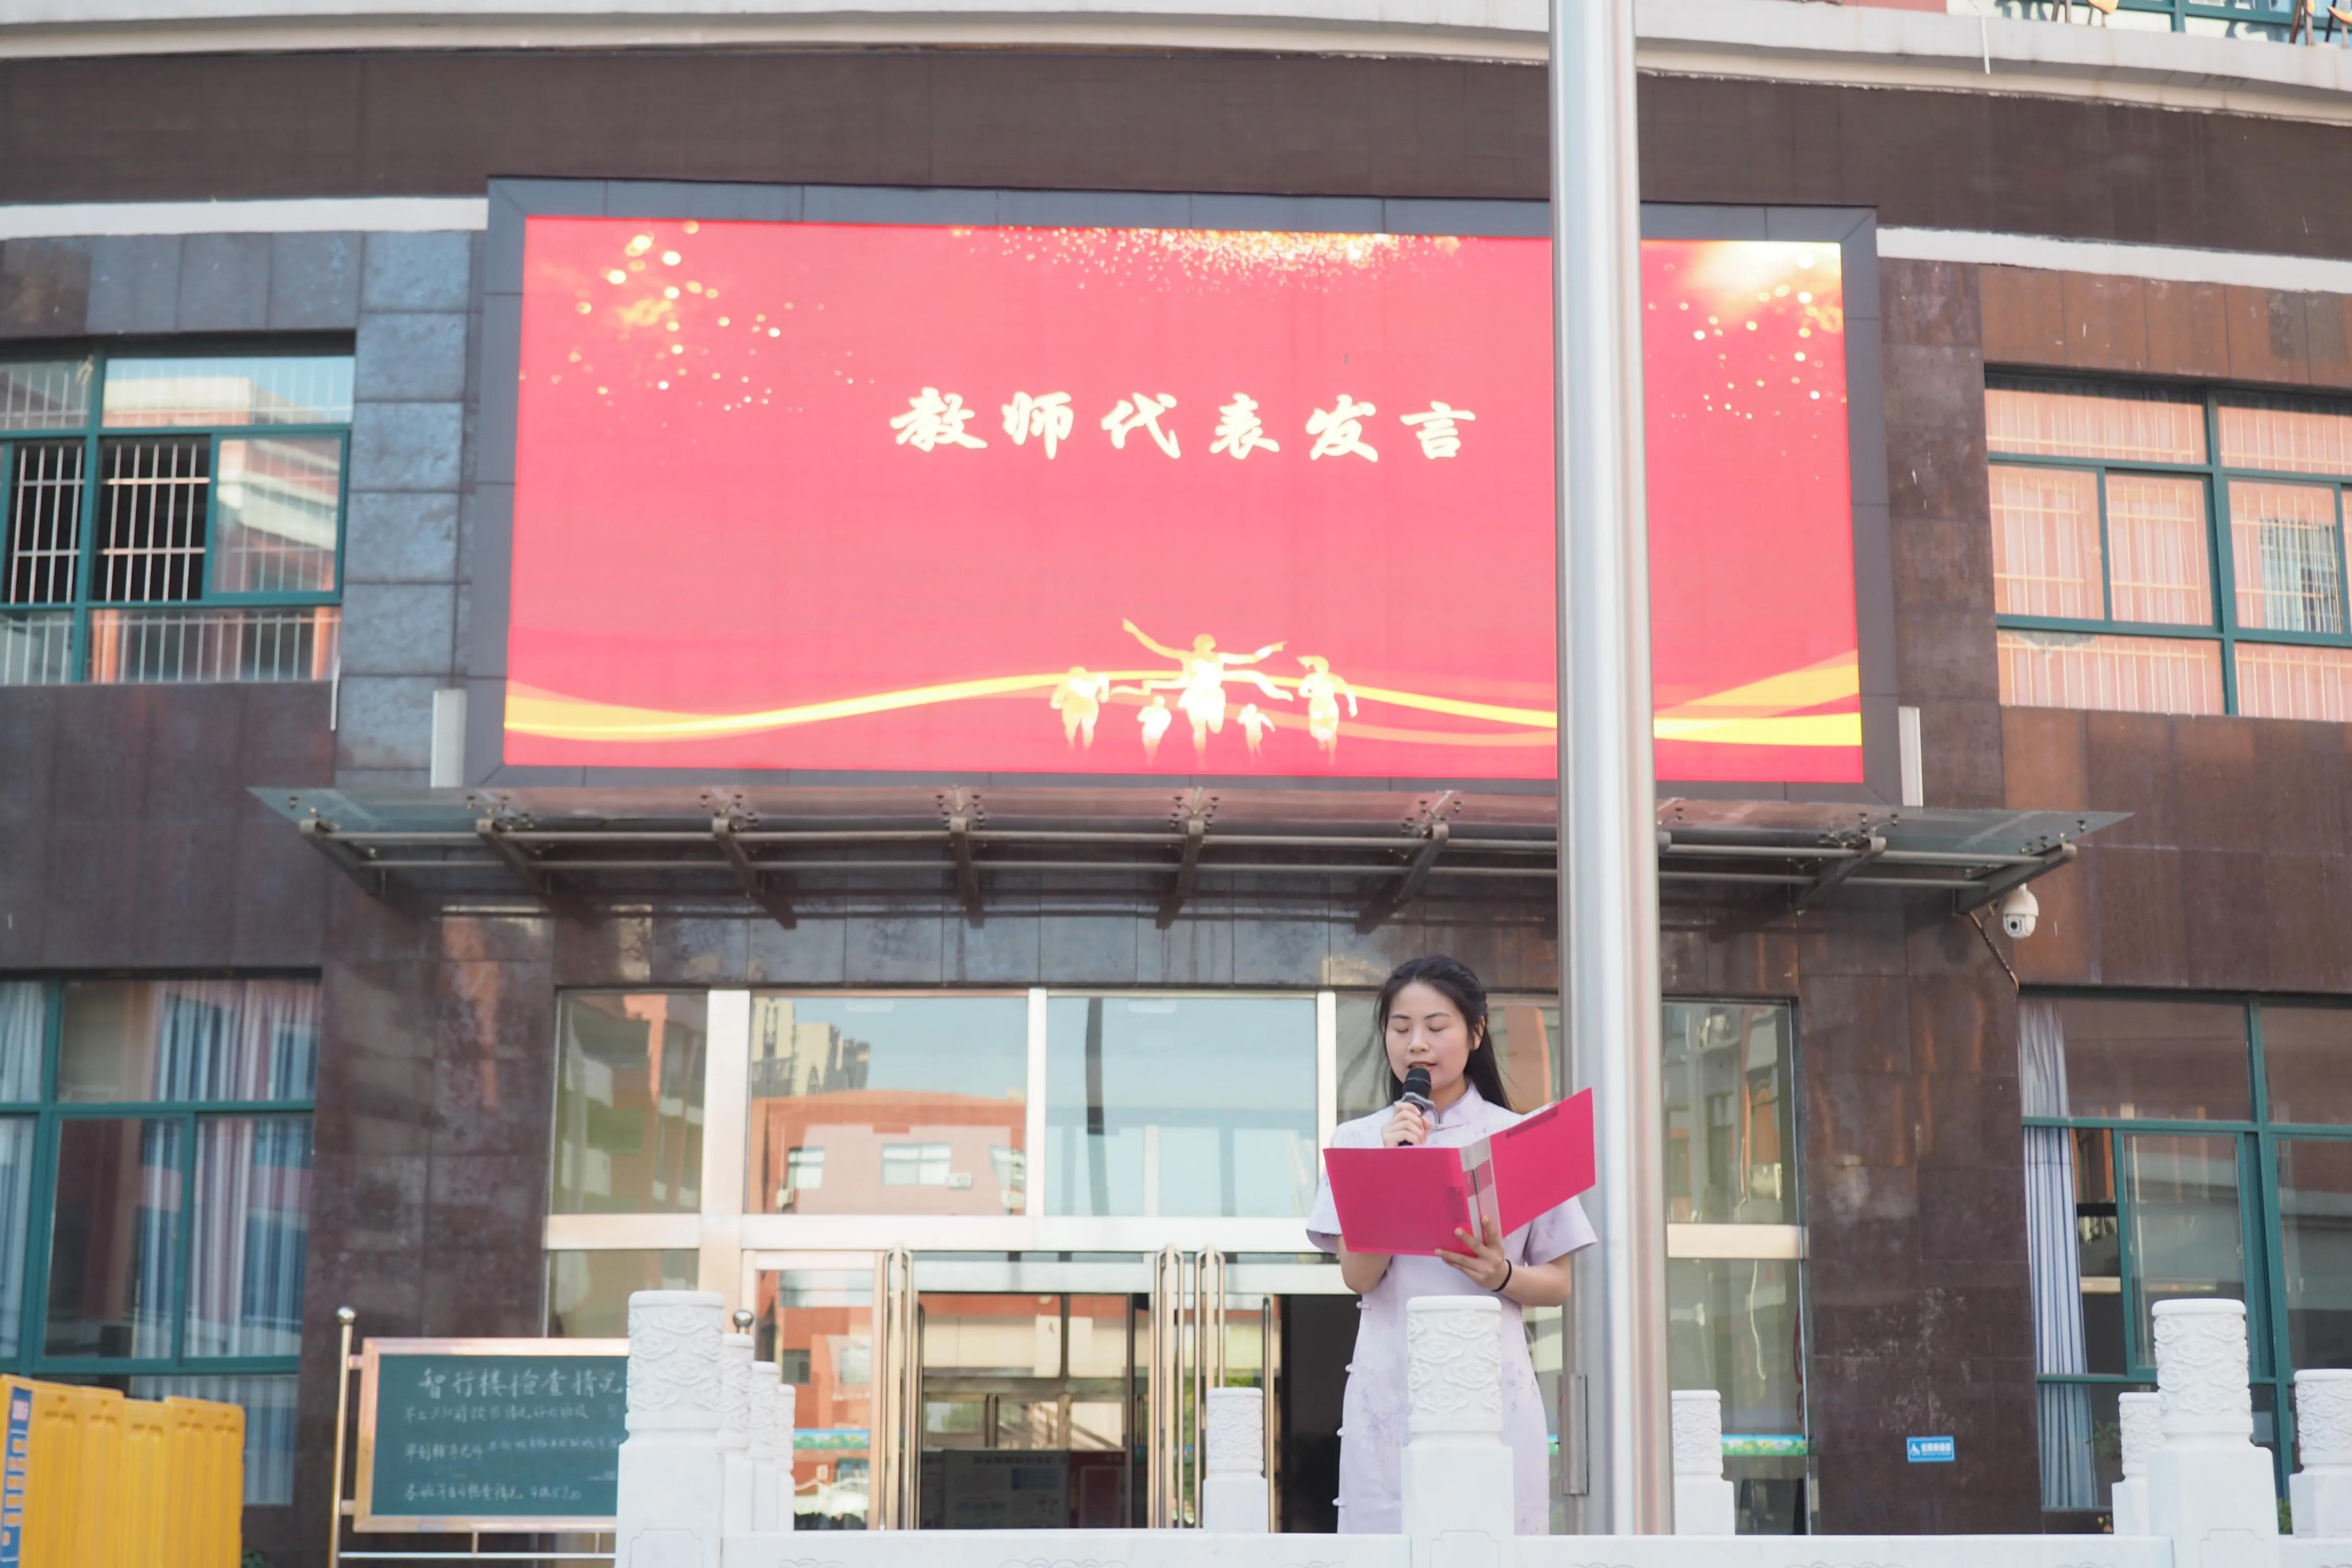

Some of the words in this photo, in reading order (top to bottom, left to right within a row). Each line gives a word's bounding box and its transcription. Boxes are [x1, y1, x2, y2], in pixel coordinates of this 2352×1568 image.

[890, 387, 1476, 462] 教师代表发言
[418, 1366, 624, 1400] 智行楼检查情况
